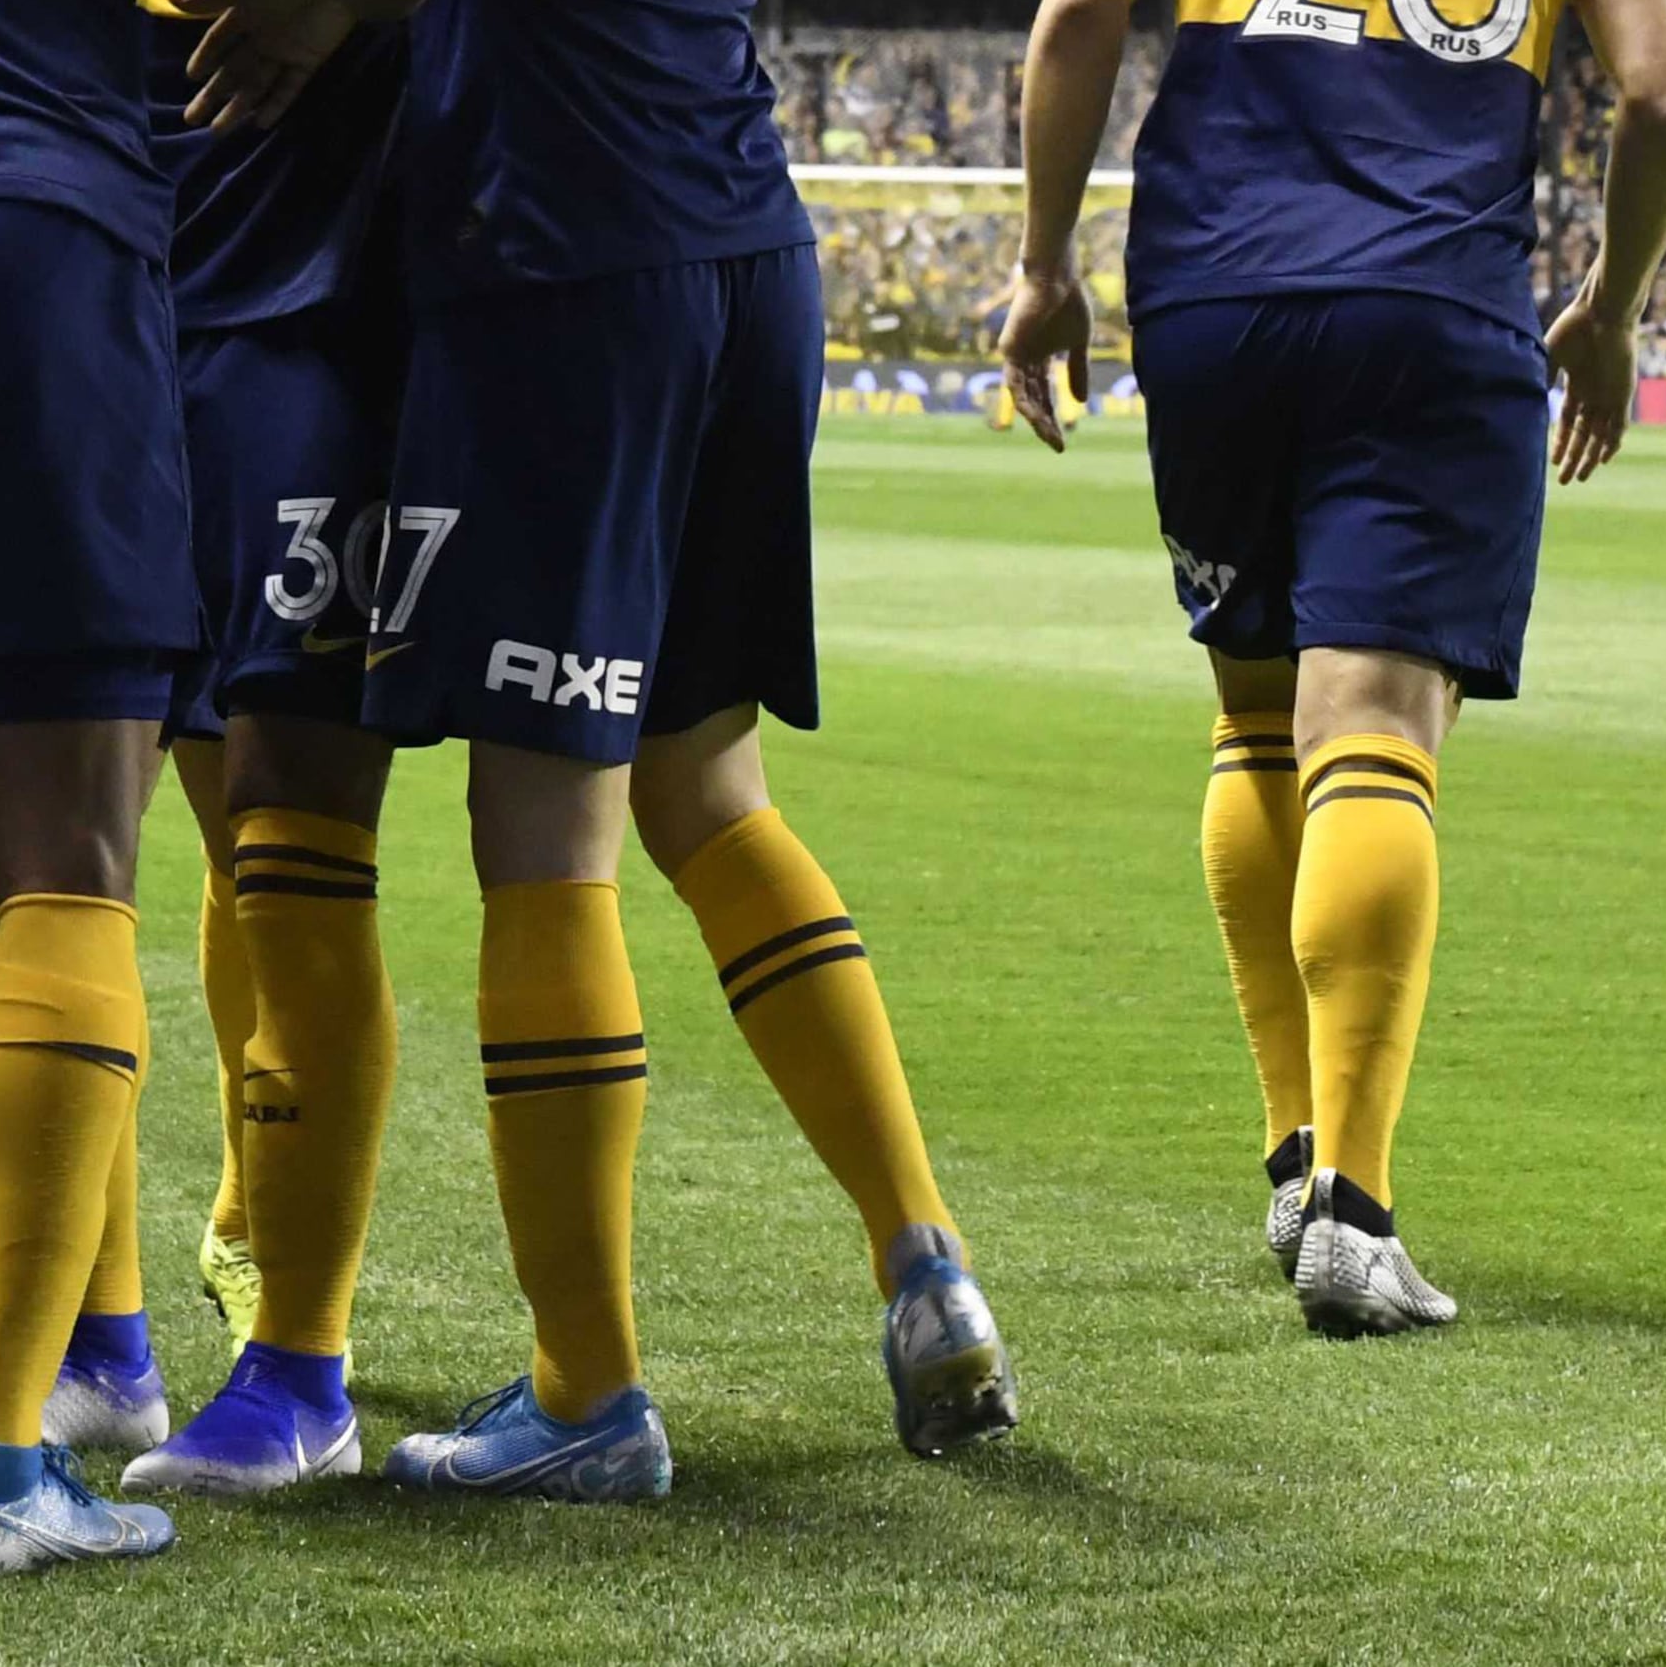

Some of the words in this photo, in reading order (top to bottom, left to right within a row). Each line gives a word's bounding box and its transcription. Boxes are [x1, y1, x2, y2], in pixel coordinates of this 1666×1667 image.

[1276, 9, 1328, 32] RUS
[1431, 32, 1482, 57] RUS
[485, 638, 644, 715] AXE
